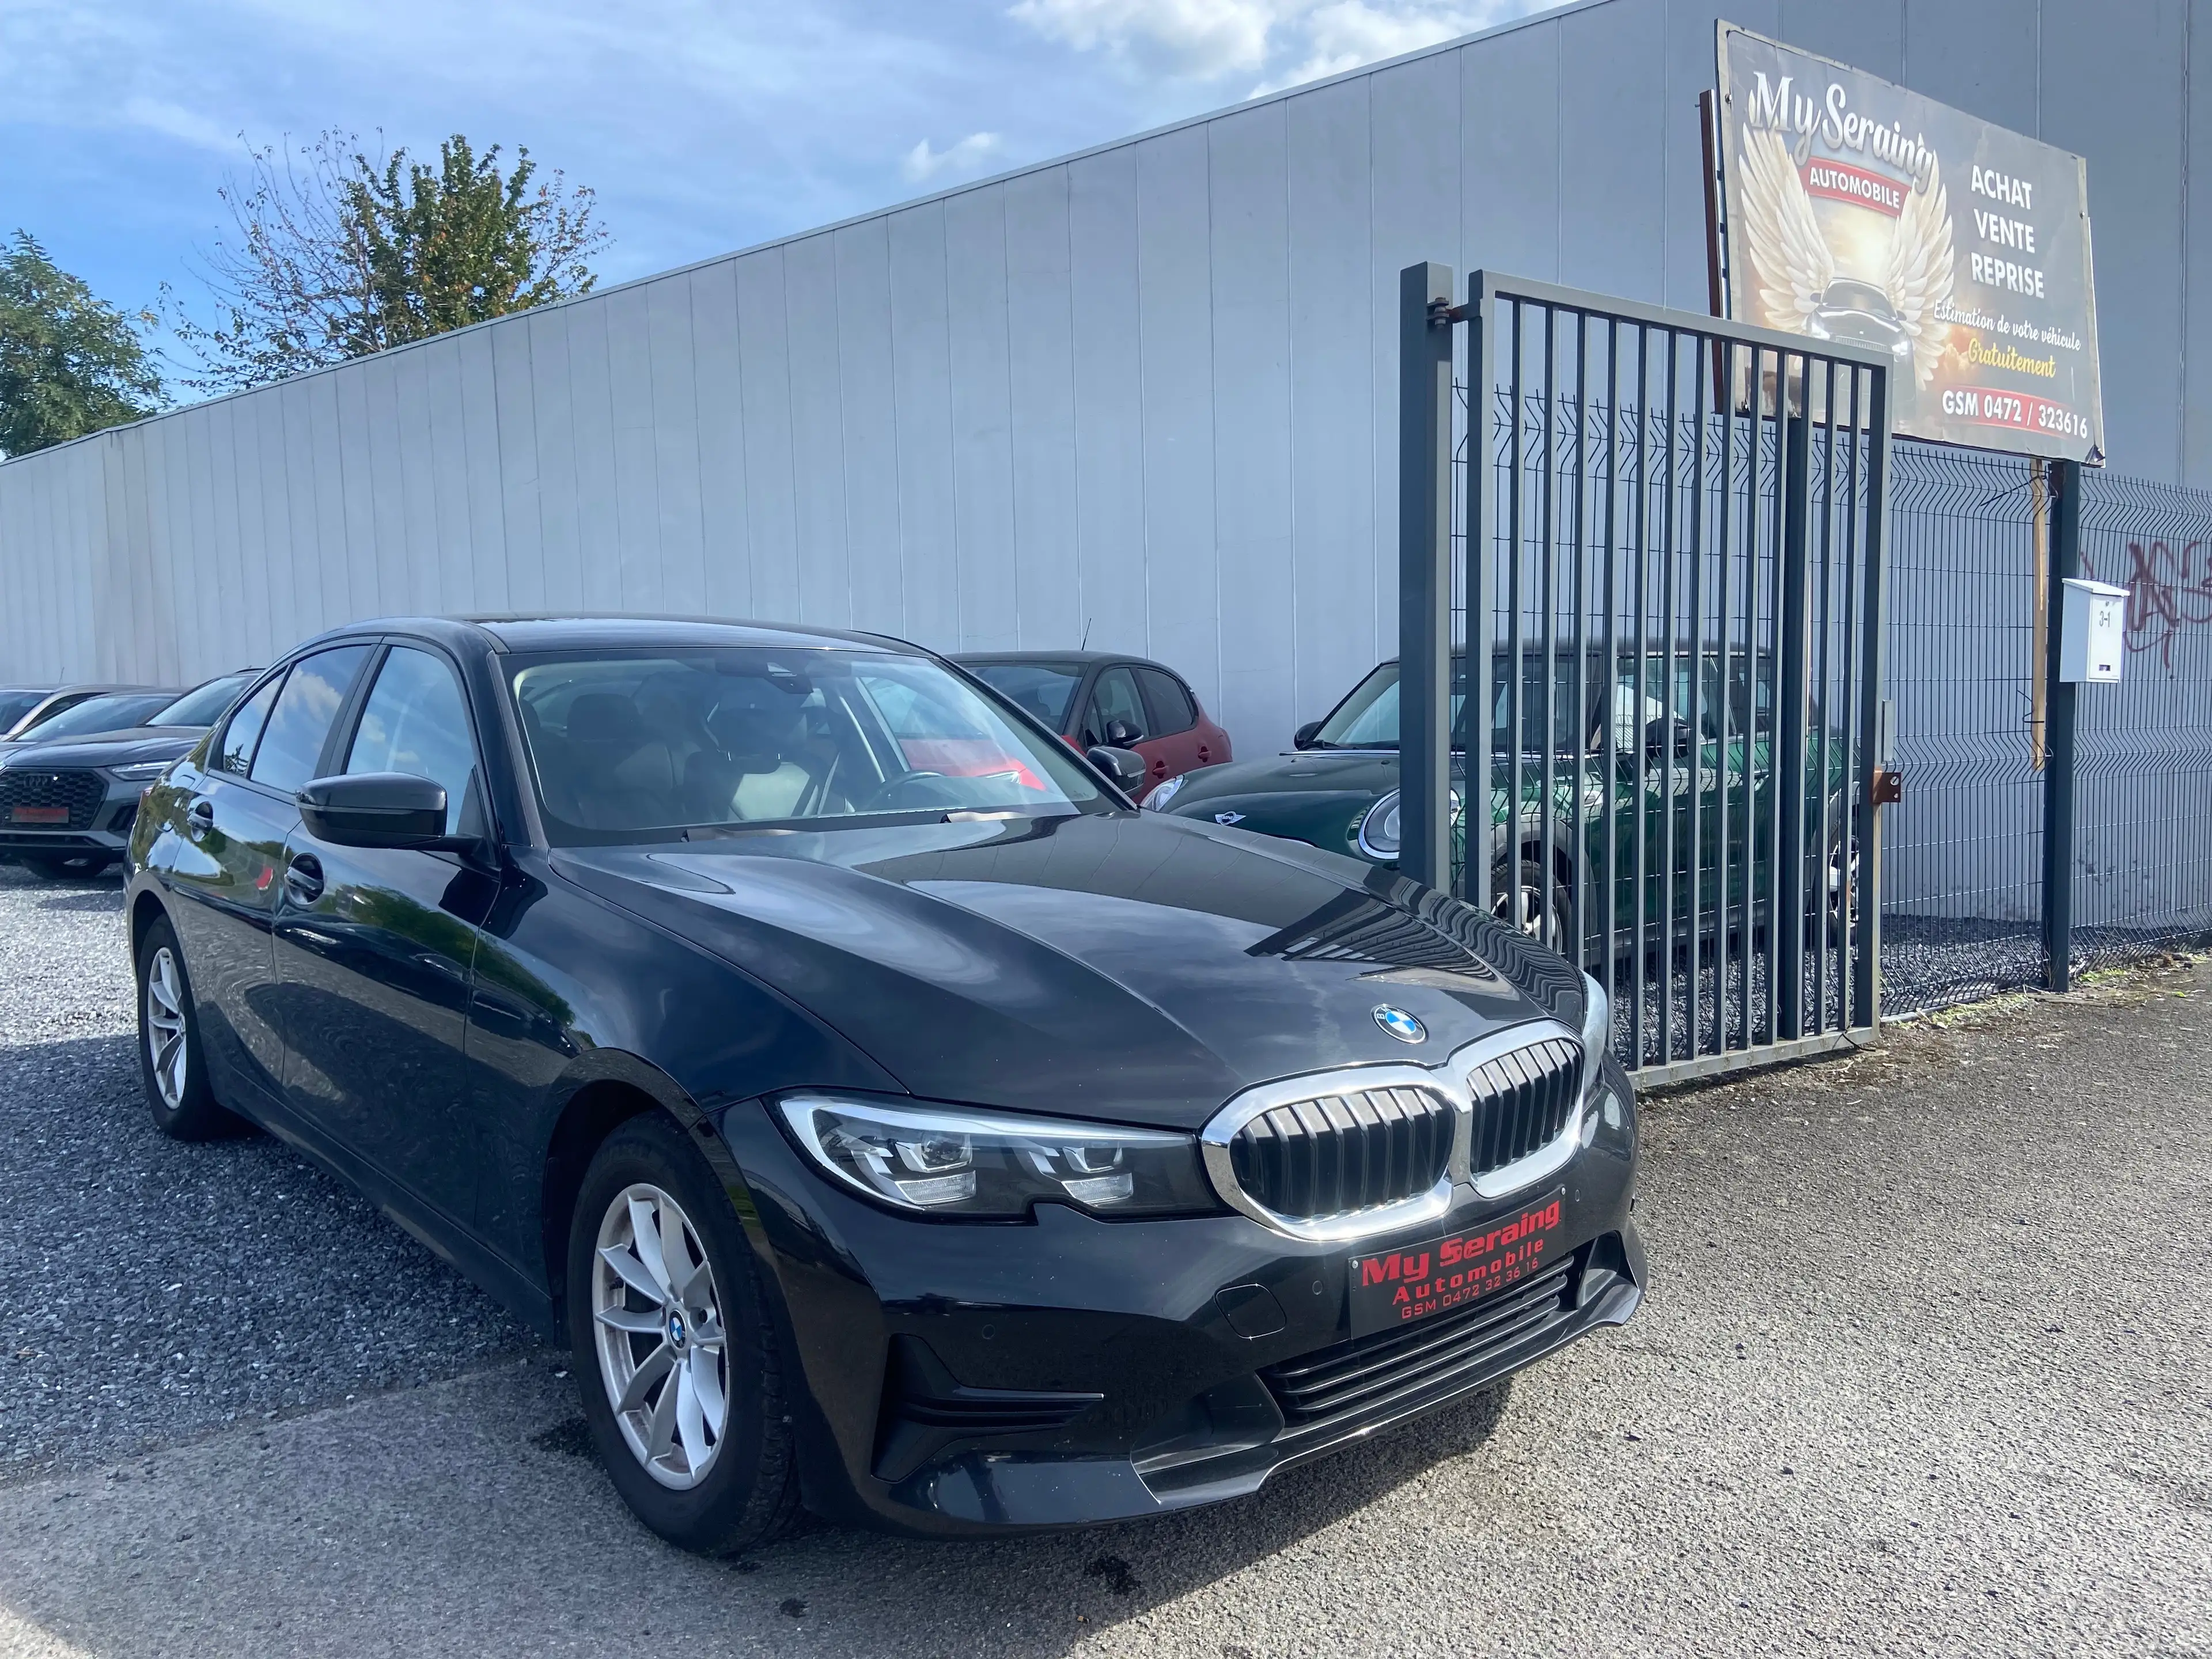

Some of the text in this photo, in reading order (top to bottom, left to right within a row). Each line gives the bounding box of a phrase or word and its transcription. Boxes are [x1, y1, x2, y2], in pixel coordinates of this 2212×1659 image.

[1752, 71, 1934, 194] My Seraing
[1809, 166, 1900, 208] AUTOMOBILE
[1971, 164, 2032, 210] ACHAT
[1974, 208, 2035, 253] VENTE
[1971, 252, 2044, 299] REPRISE
[1934, 298, 2081, 351] Estimation de votre véhicule
[1968, 338, 2056, 378] Gratuitement
[1942, 390, 2088, 439] GSM 0472 / 323616
[1362, 1200, 1560, 1286] My Seraing
[1392, 1238, 1544, 1305] Automobile
[1402, 1257, 1539, 1319] GSM 0472 32 36 16
